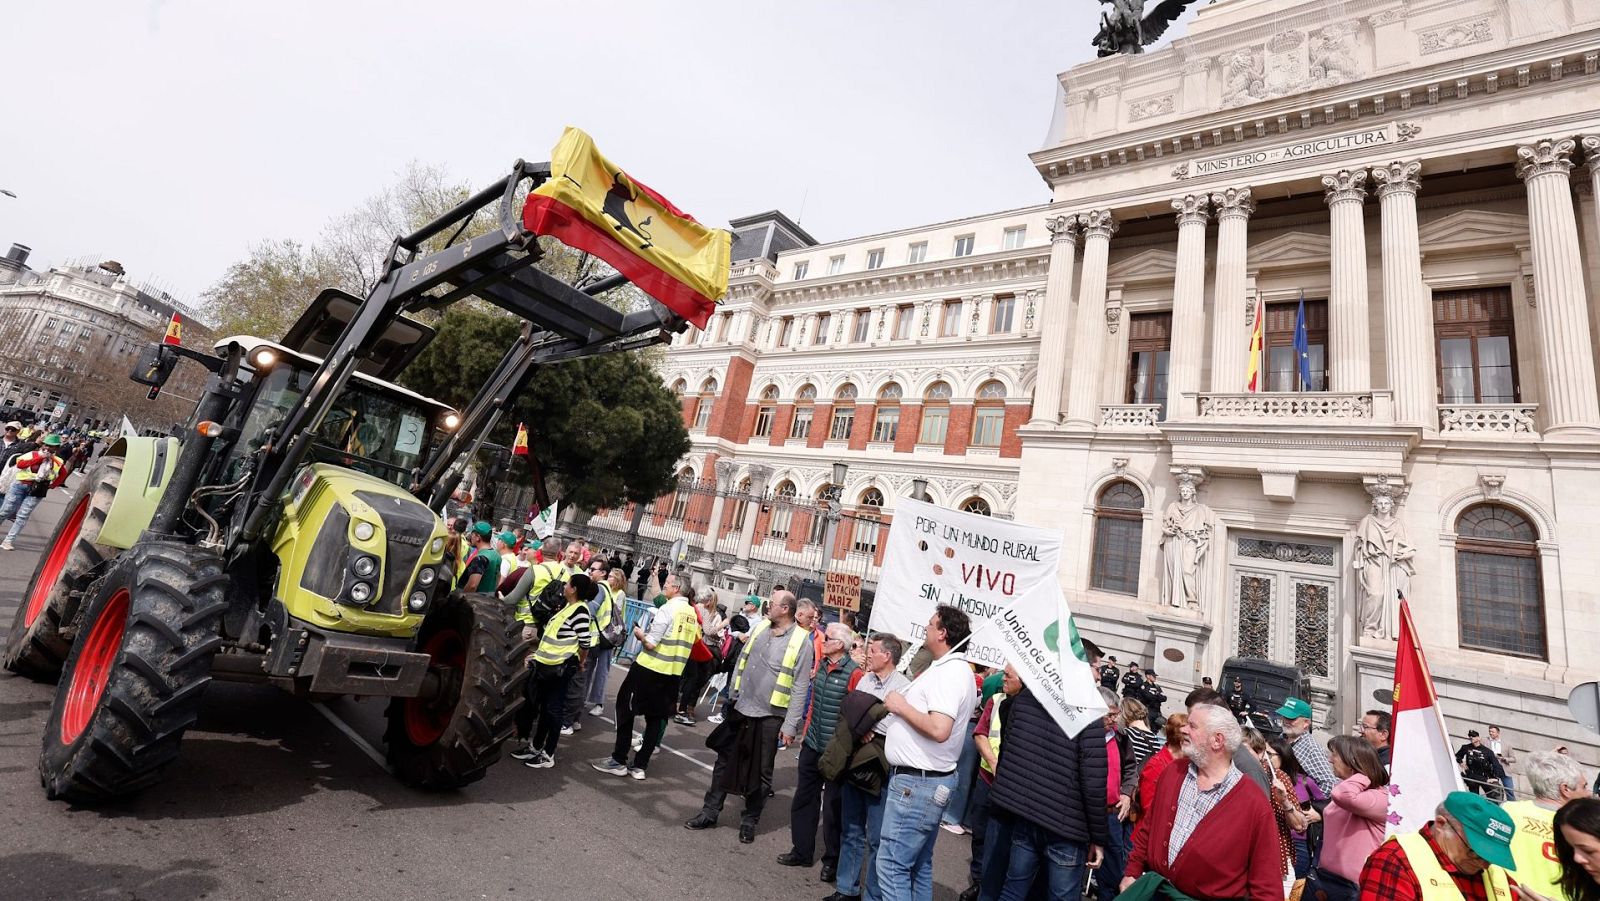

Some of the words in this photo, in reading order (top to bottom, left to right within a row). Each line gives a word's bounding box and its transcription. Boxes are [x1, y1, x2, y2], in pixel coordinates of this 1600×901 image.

[1196, 152, 1267, 173] MINISTERIO
[1283, 131, 1386, 158] AGRICULTURA
[403, 422, 419, 446] 3
[916, 516, 937, 535] POR
[943, 525, 959, 542] UN
[962, 531, 999, 553] MUNDO
[1002, 541, 1040, 561] RURAL
[847, 575, 859, 587] NO
[961, 563, 1015, 596] VIVO
[950, 593, 1005, 619] LIMOSNA
[1003, 609, 1033, 648] Unión
[1029, 647, 1045, 664] de
[1002, 628, 1039, 675] Agricultores
[1041, 678, 1077, 721] Ganaderos
